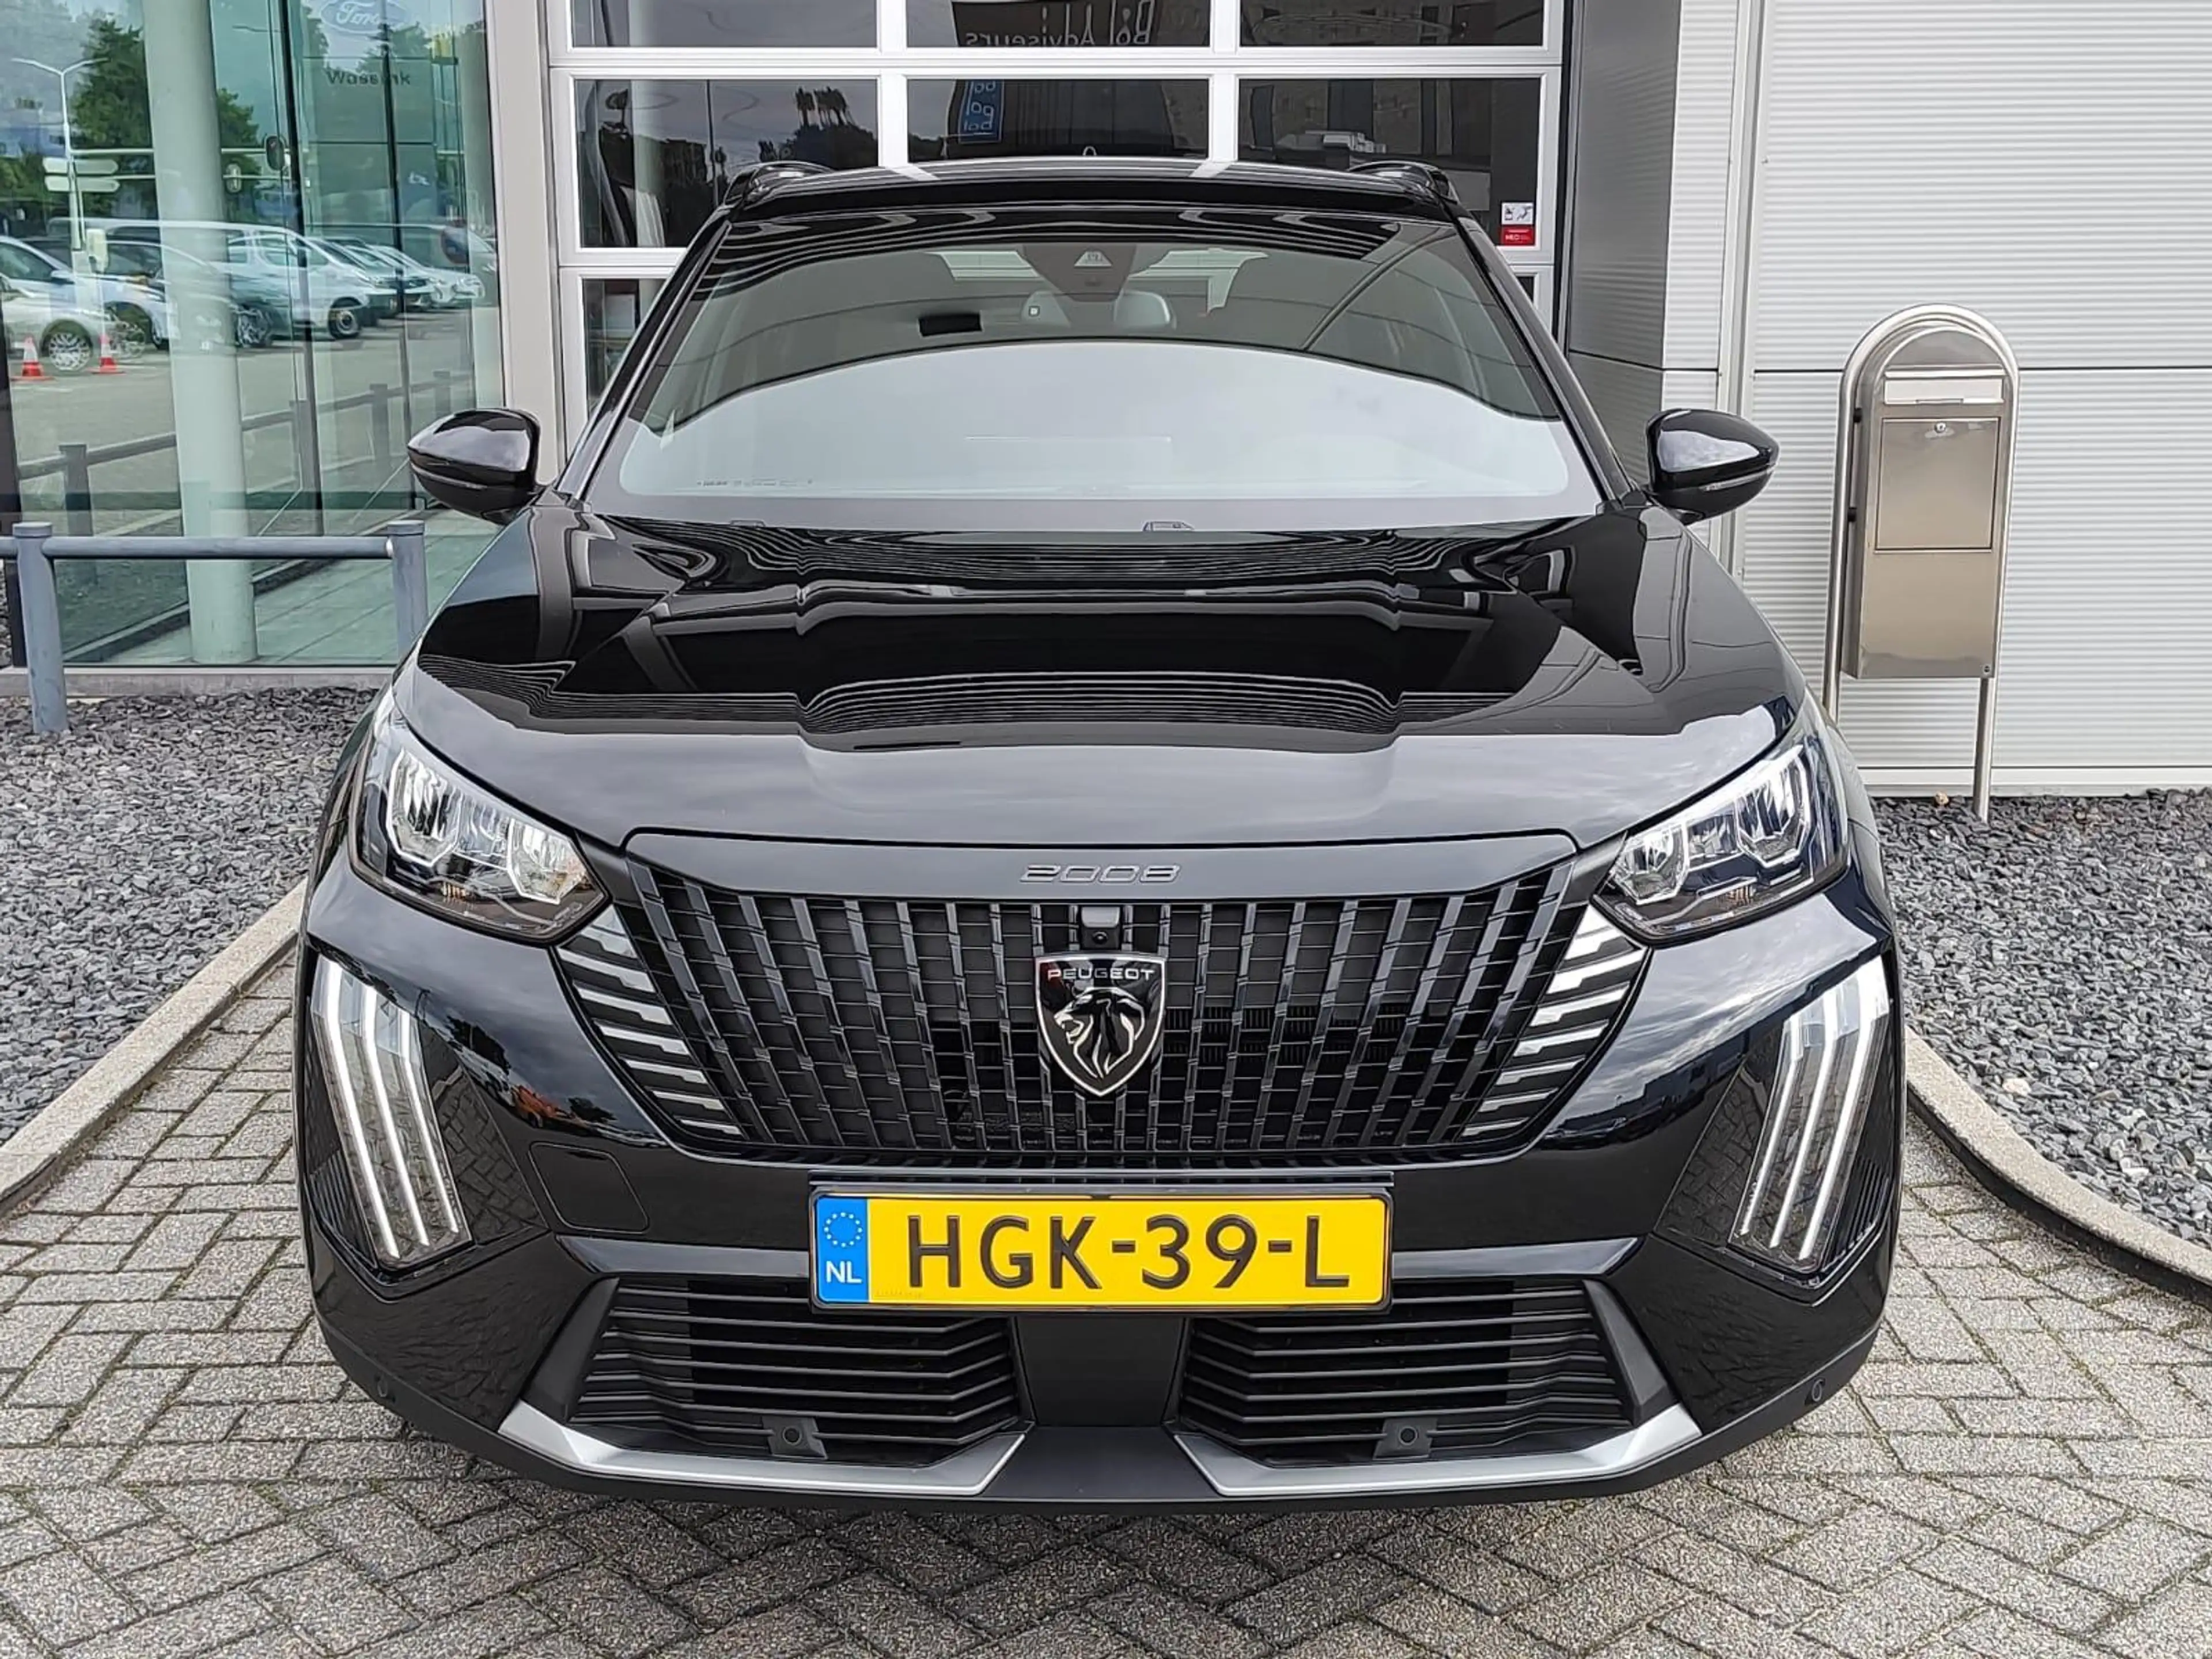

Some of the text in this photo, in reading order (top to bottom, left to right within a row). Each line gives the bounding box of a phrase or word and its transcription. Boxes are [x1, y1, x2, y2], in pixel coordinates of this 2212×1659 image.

[325, 70, 411, 85] Wassnk
[1020, 865, 1180, 883] 2008
[1047, 968, 1156, 980] PEUGEOT
[907, 1214, 1350, 1289] HGK-39-L
[826, 1261, 862, 1285] NL
